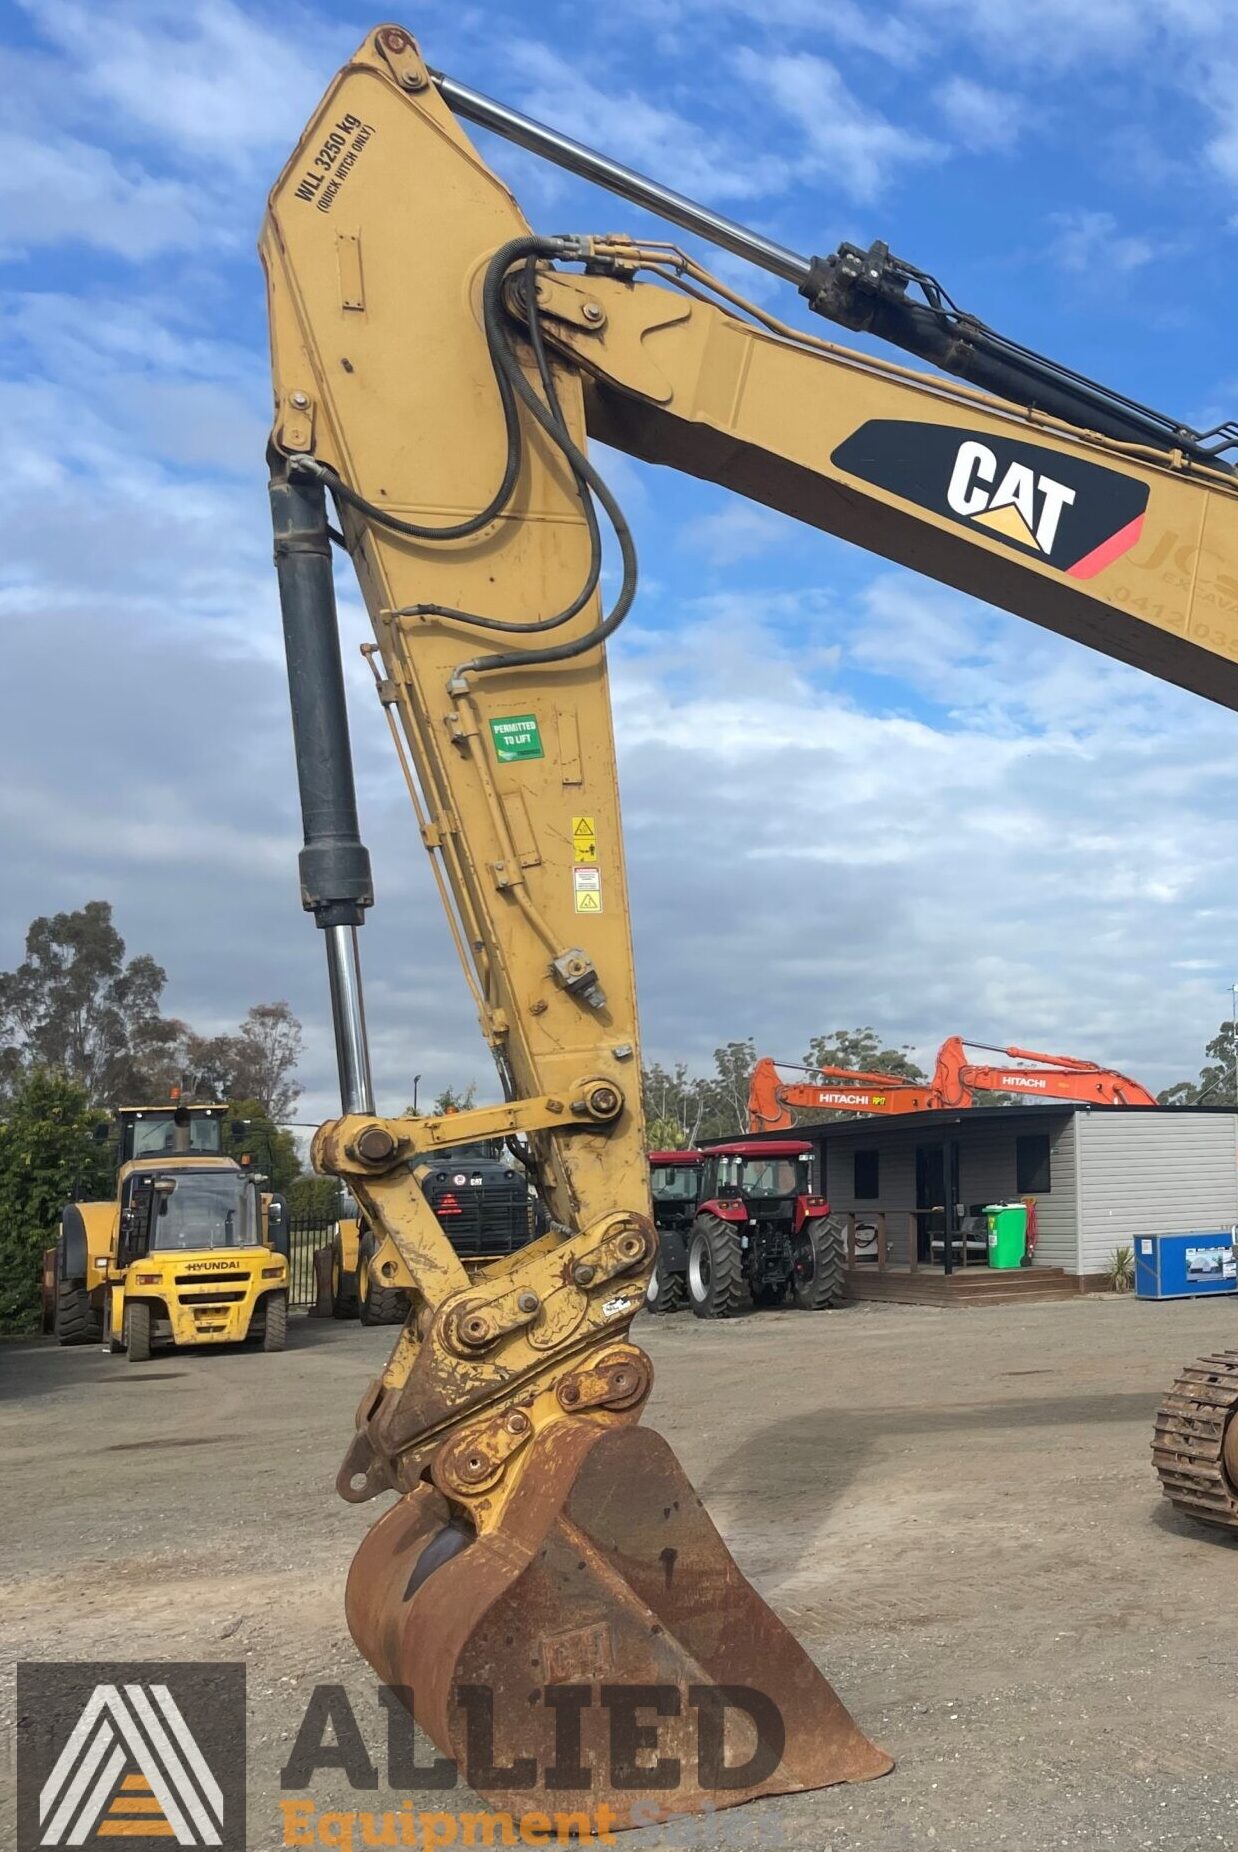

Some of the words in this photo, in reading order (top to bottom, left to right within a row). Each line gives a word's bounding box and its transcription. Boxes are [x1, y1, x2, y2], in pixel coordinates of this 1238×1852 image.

[294, 171, 325, 203] WLL
[314, 132, 346, 171] 3250
[335, 113, 362, 135] kg
[316, 178, 342, 214] (QUICK
[334, 151, 358, 181] HITCH
[351, 124, 376, 153] ONLY)
[946, 440, 1077, 556] CAT
[493, 721, 537, 734] PERMITTED
[503, 735, 515, 745] TO
[515, 733, 531, 744] LIFT
[1002, 1076, 1047, 1088] HITACHI
[819, 1093, 869, 1105] HITACHI
[185, 1261, 240, 1271] HYUNDAI
